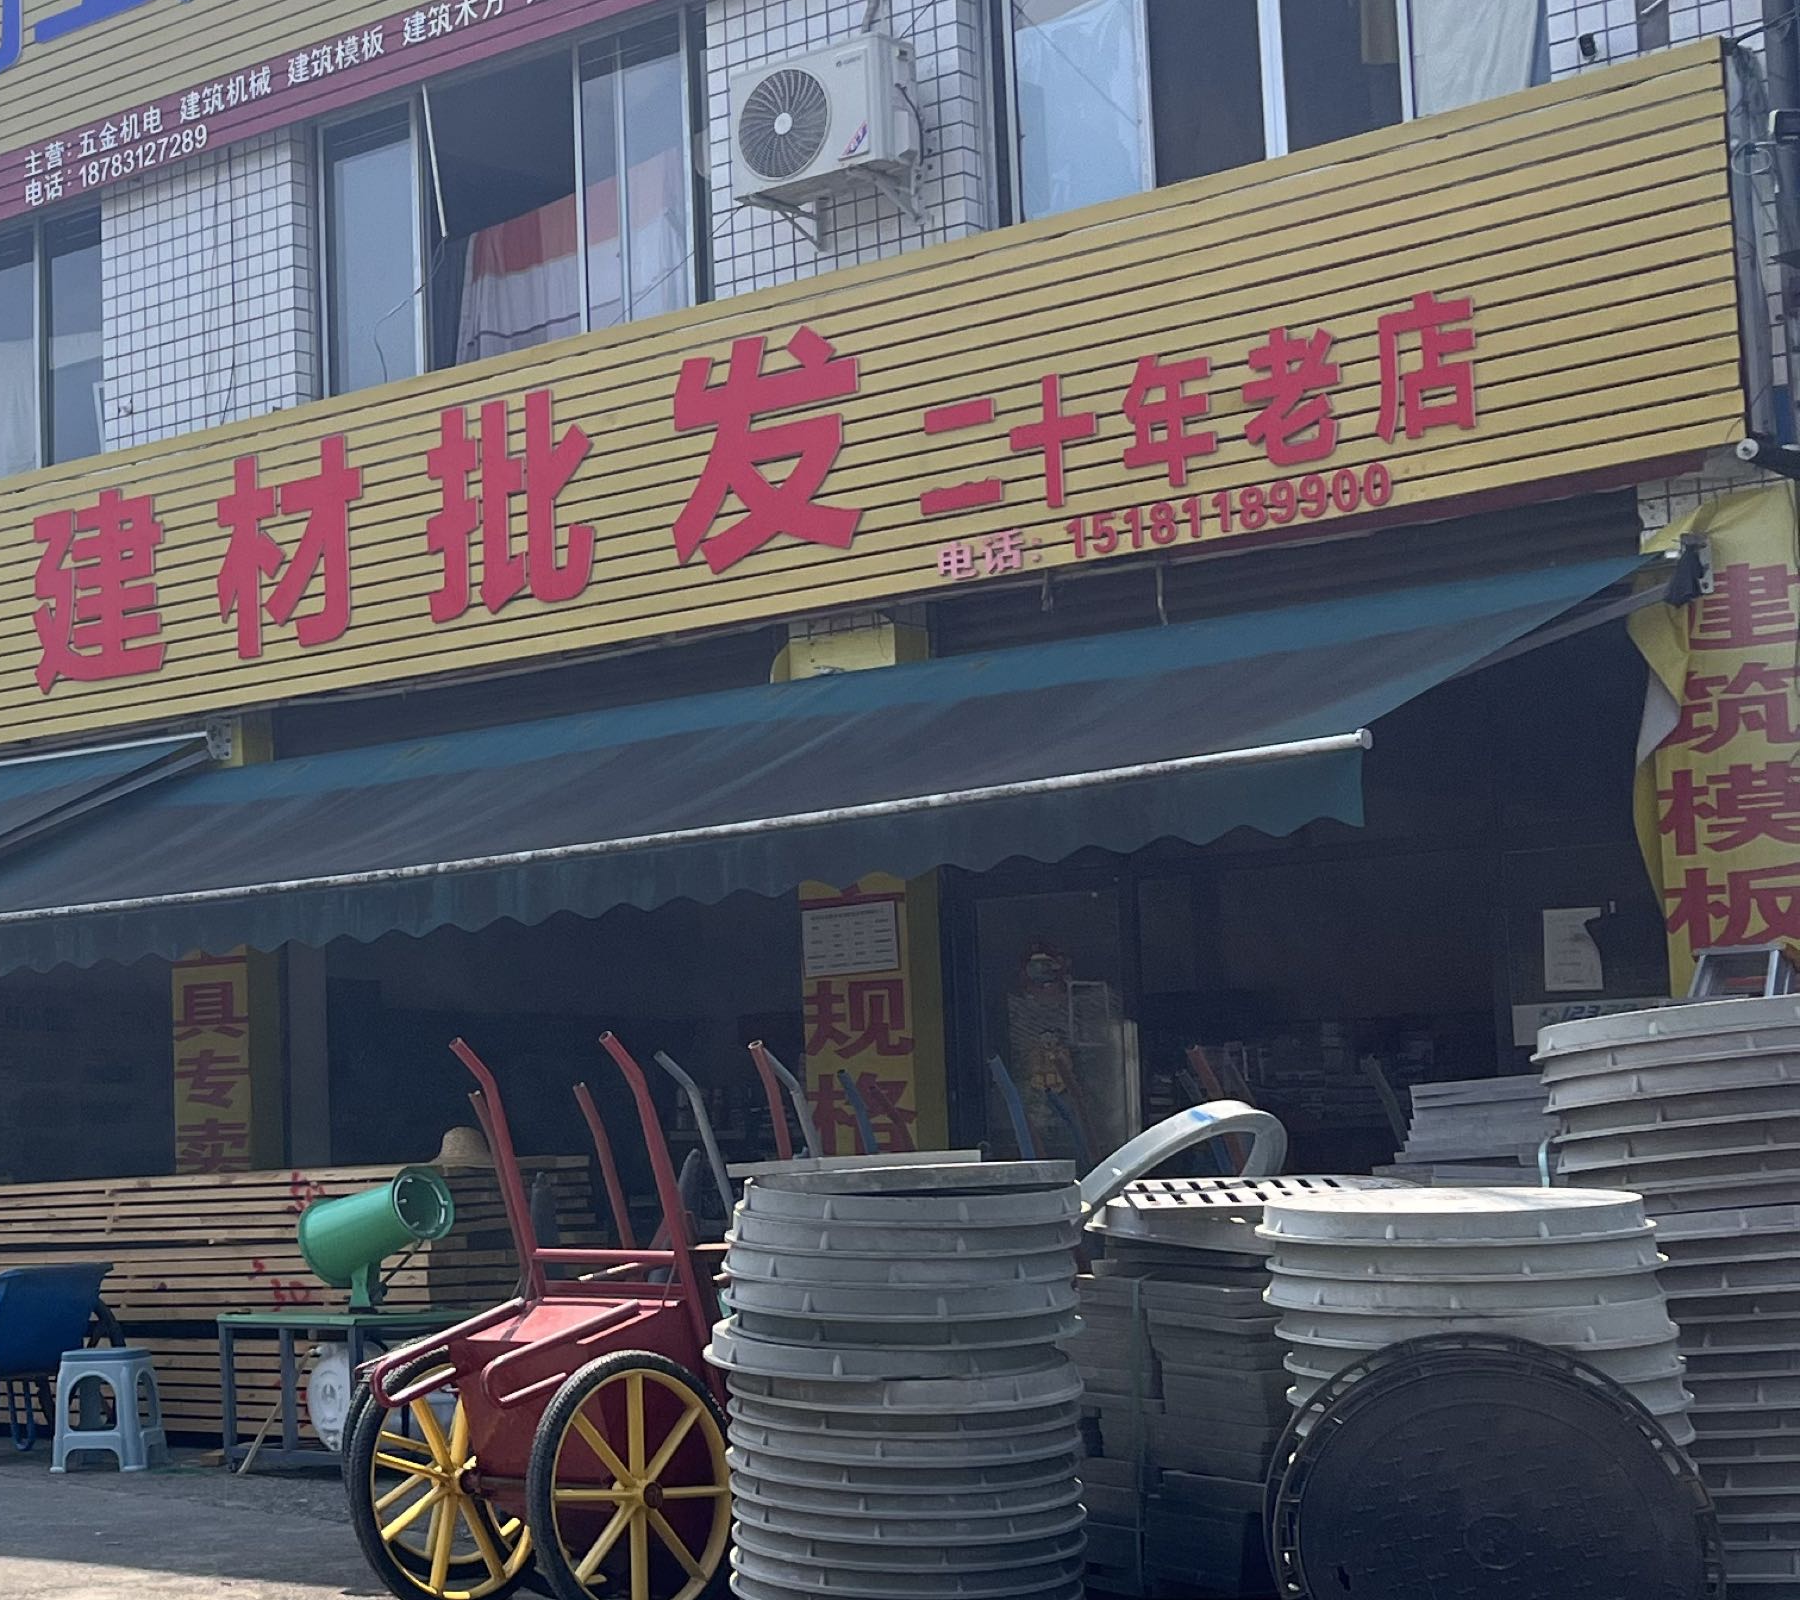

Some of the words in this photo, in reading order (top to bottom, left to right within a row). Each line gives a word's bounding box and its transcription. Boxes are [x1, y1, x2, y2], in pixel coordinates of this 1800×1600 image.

[179, 65, 273, 124] 建筑机械
[287, 25, 385, 88] 建筑模板
[919, 289, 1479, 516] 二十年老店
[171, 952, 249, 1173] 具专卖
[800, 882, 918, 1158] 规格
